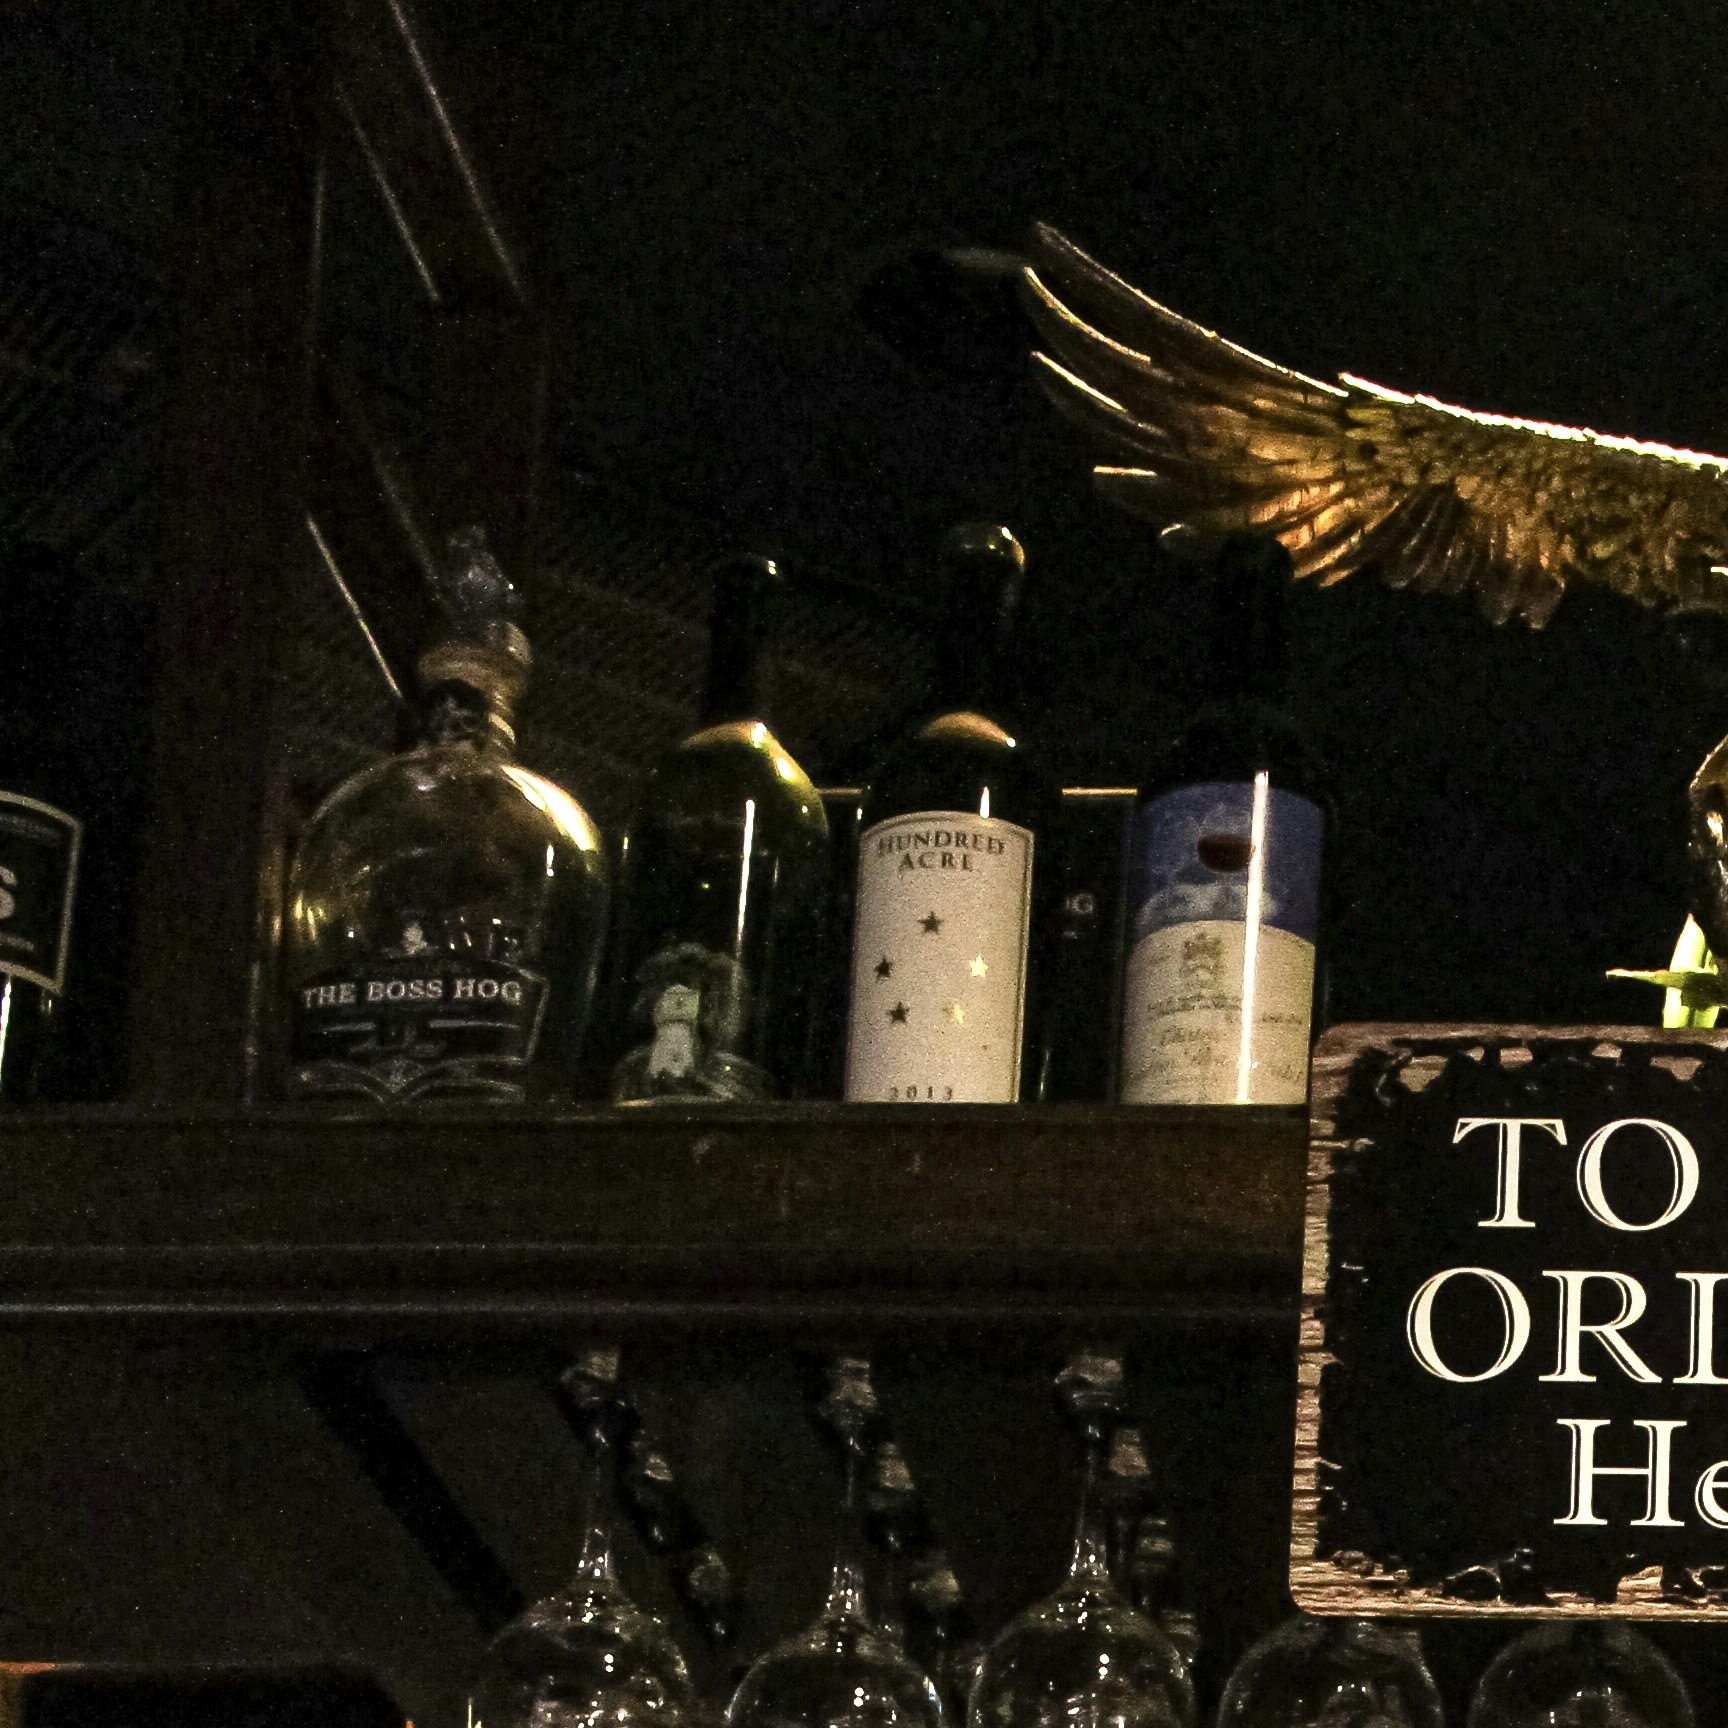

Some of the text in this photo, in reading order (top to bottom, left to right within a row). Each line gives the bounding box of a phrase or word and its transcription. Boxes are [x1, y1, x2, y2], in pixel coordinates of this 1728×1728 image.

[878, 831, 1005, 855] HUNDRED
[303, 978, 523, 1008] THE BOSS HOG
[1453, 1117, 1701, 1232] TO
